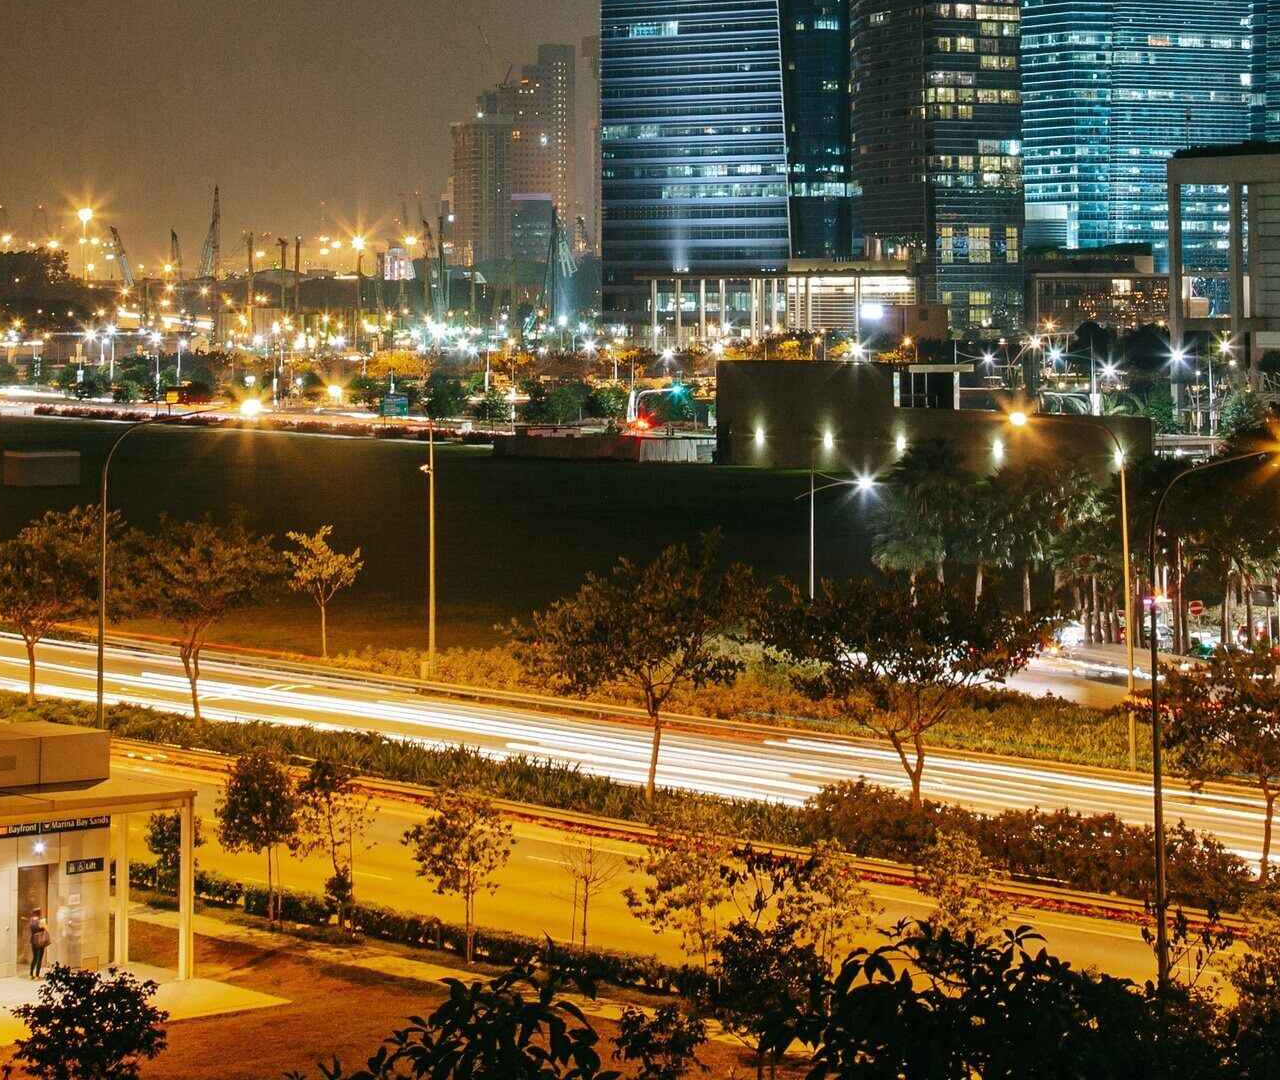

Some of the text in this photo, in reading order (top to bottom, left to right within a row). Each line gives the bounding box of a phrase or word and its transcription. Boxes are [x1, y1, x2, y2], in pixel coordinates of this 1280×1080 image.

[8, 823, 37, 834] Bayfront
[51, 820, 75, 829] Marina
[76, 819, 88, 828] Bay
[89, 816, 109, 825] Sands
[85, 861, 96, 870] Lift
